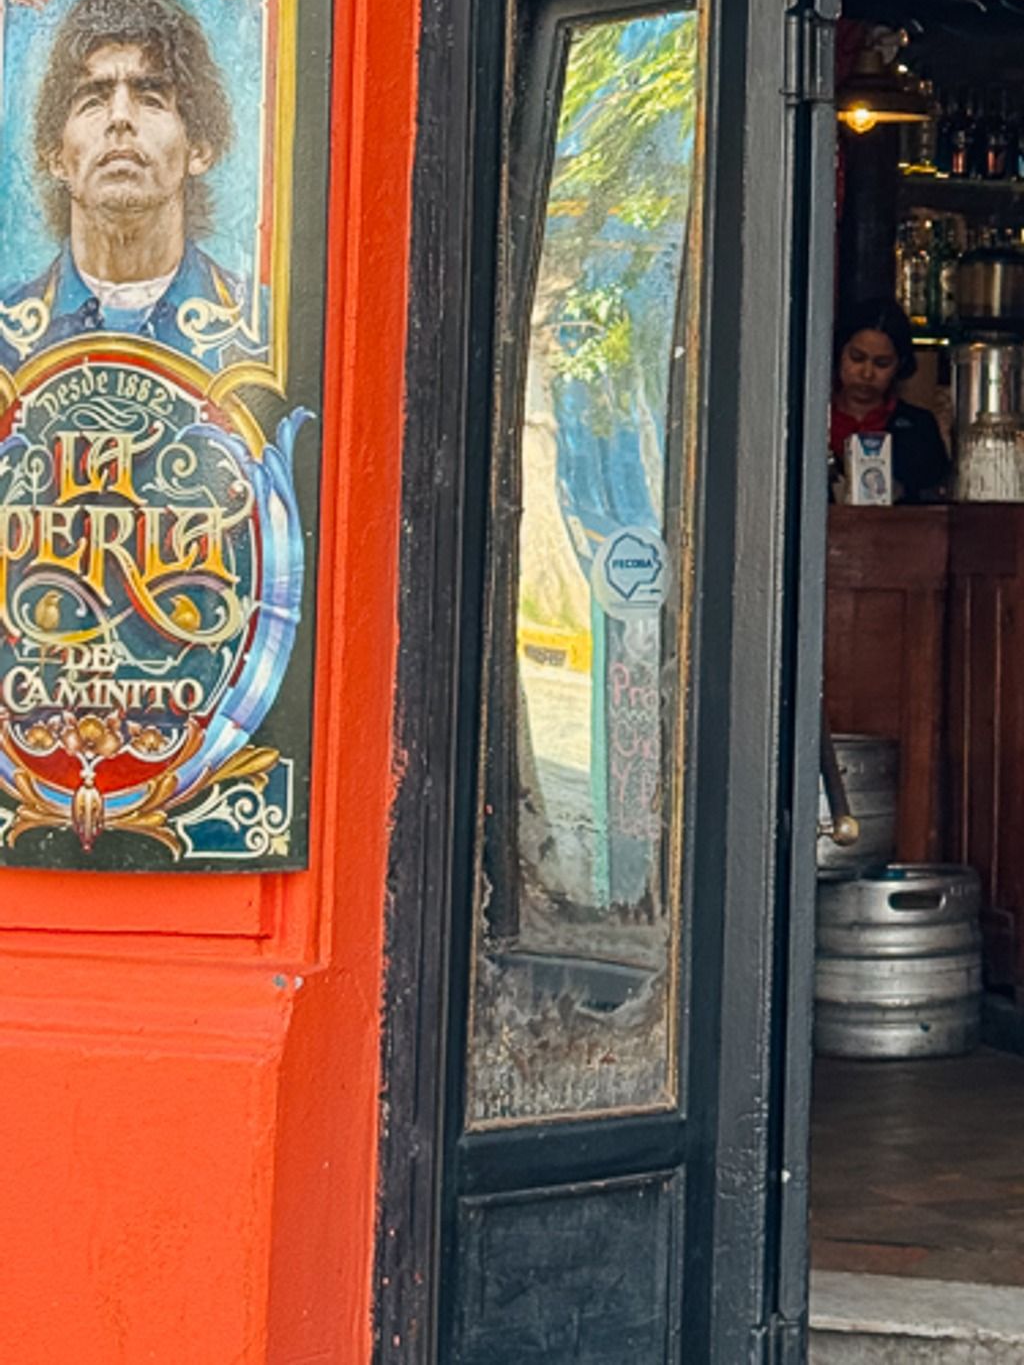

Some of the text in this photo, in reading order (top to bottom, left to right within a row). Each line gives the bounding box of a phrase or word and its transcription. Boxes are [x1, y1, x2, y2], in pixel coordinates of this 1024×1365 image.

[54, 422, 162, 505] LA
[0, 502, 242, 644] PERLA
[63, 641, 118, 675] DE
[3, 669, 204, 714] CAMINITO
